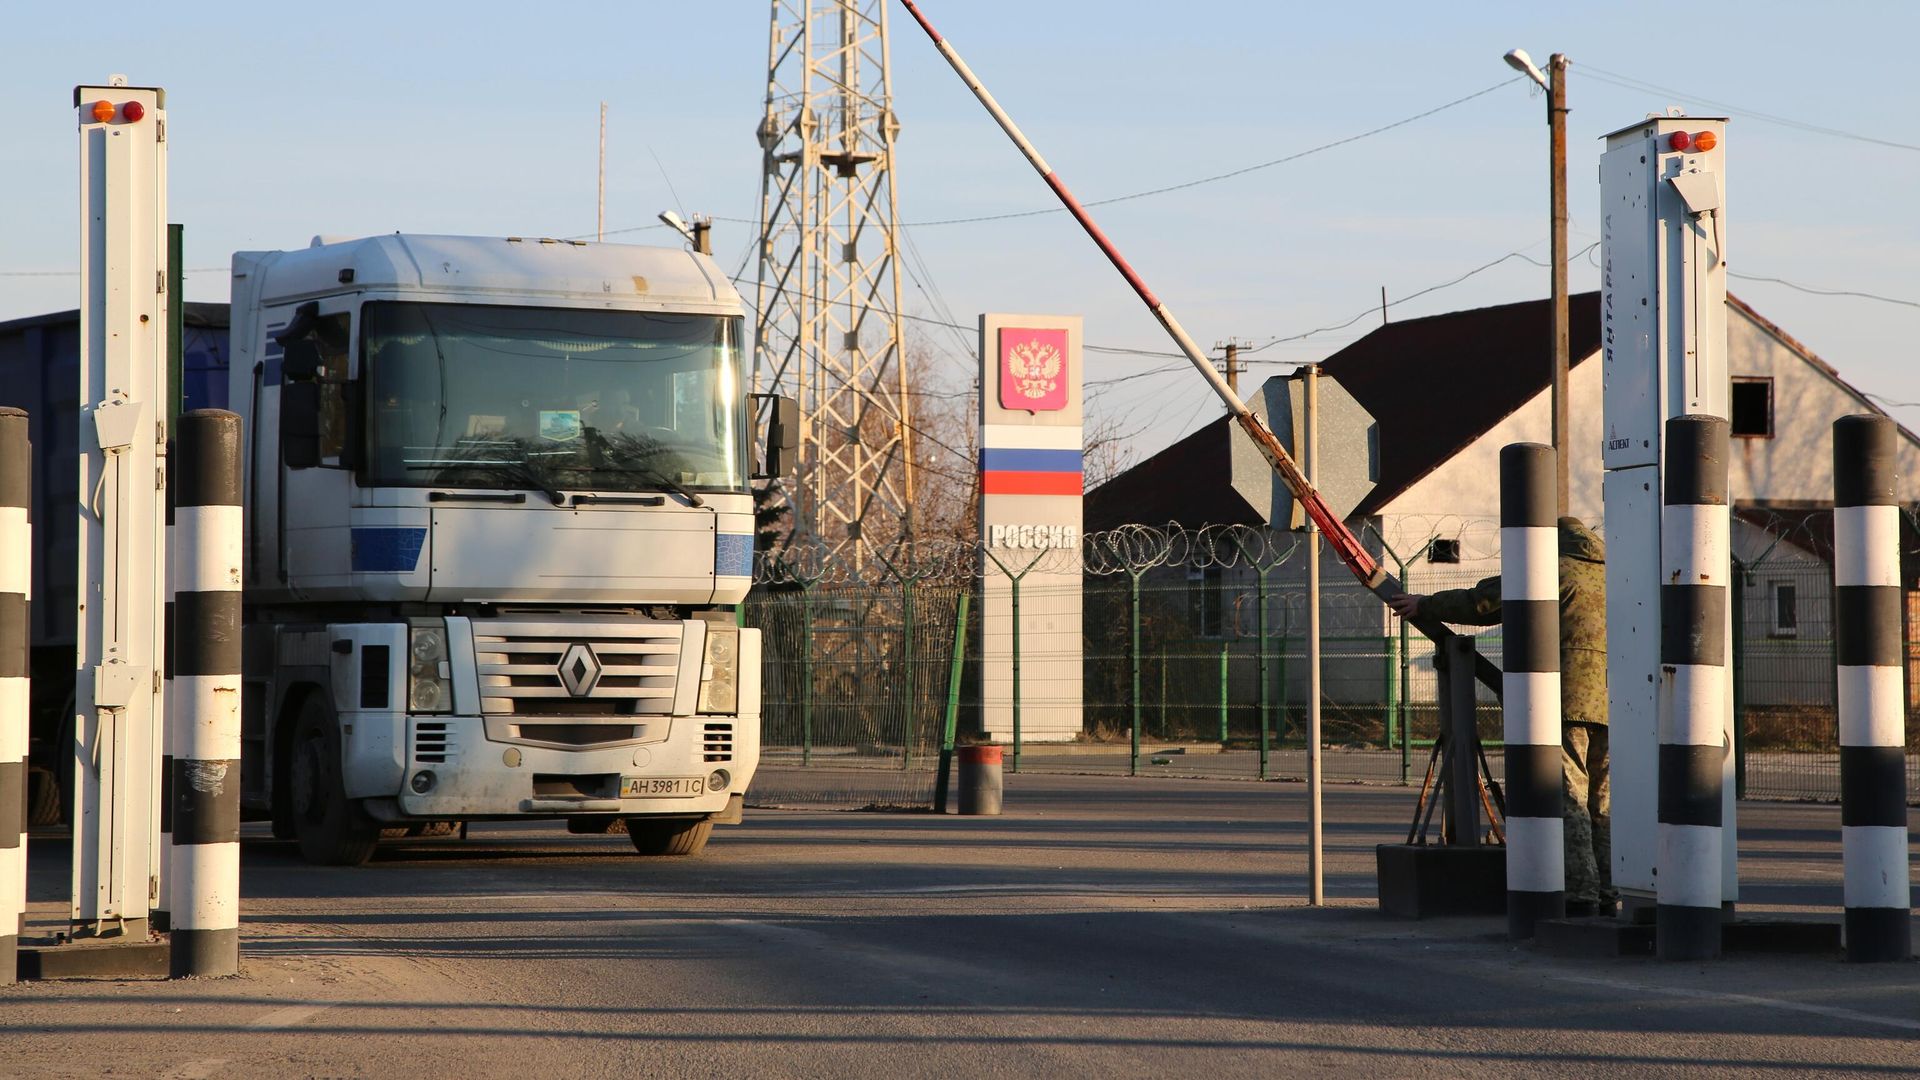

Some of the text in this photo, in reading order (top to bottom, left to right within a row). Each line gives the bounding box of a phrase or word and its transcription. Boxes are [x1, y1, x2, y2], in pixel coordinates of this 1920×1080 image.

[990, 524, 1077, 549] РОССИЯ
[630, 780, 649, 793] AH
[651, 780, 680, 793] 3981
